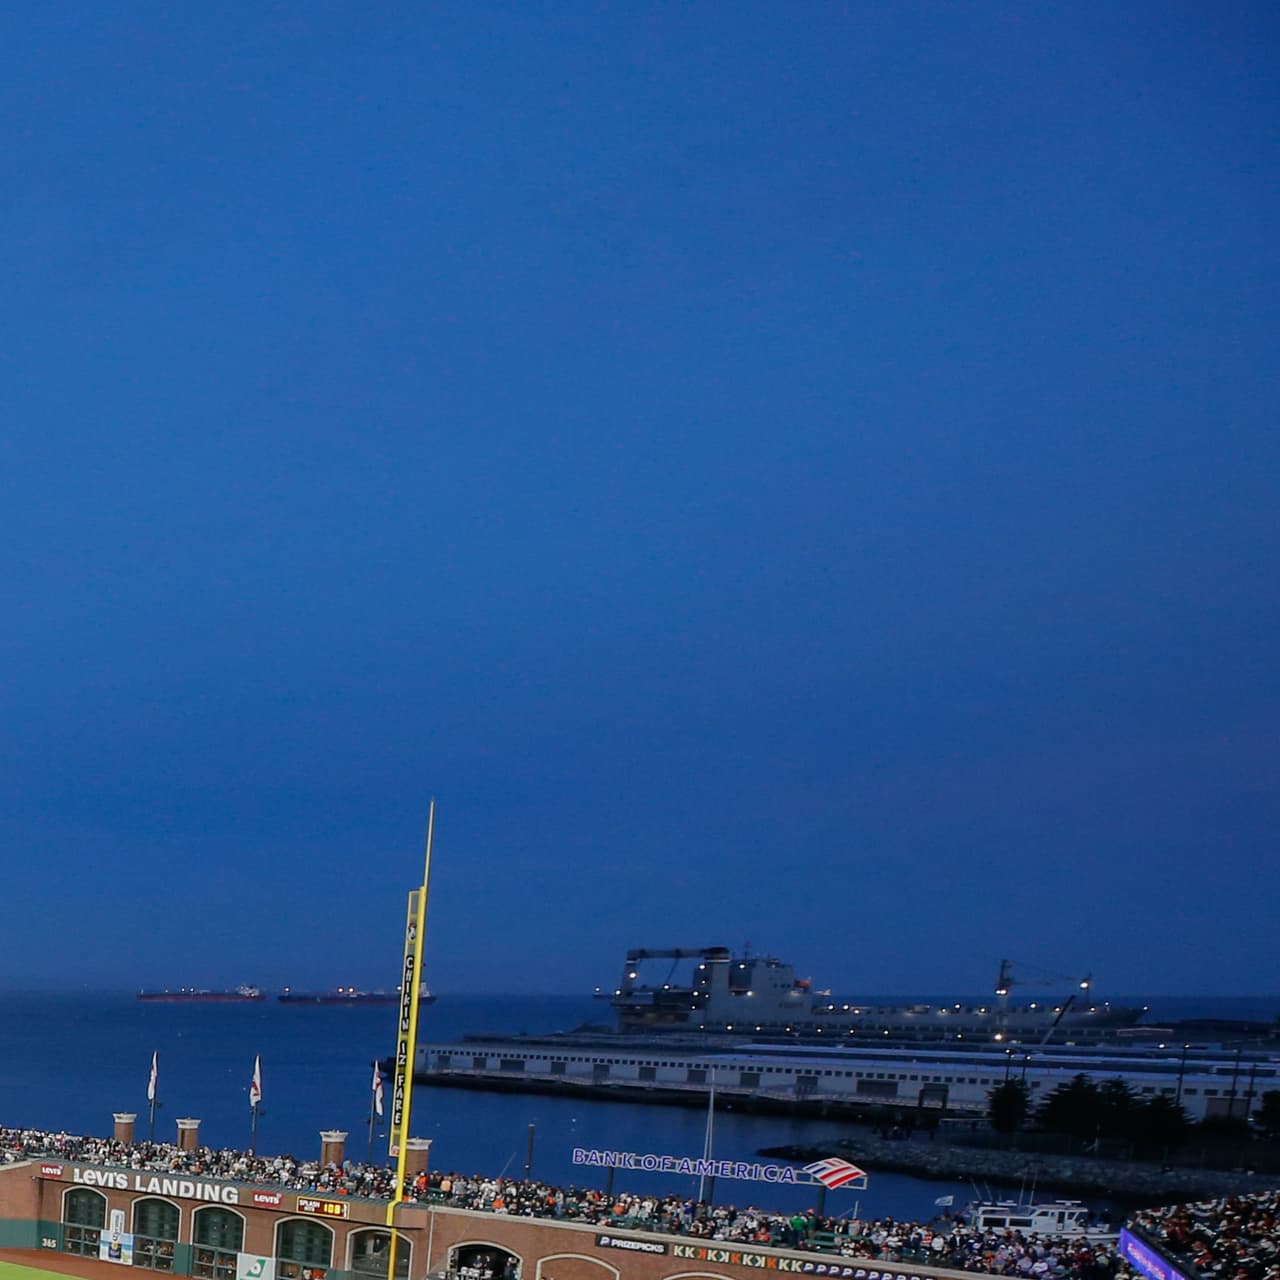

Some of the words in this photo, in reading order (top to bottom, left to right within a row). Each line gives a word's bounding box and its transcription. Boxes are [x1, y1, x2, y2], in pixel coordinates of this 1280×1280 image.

[400, 956, 414, 1031] CHIKIN
[399, 1042, 407, 1066] IZ
[393, 1074, 405, 1124] FARE
[572, 1148, 636, 1169] BANK
[640, 1153, 672, 1171] OF
[677, 1158, 797, 1183] AMERICA
[134, 1175, 239, 1204] LANDING
[299, 1200, 321, 1208] SPLASH
[41, 1237, 57, 1248] 365
[611, 1239, 665, 1253] PRIZEPICKS
